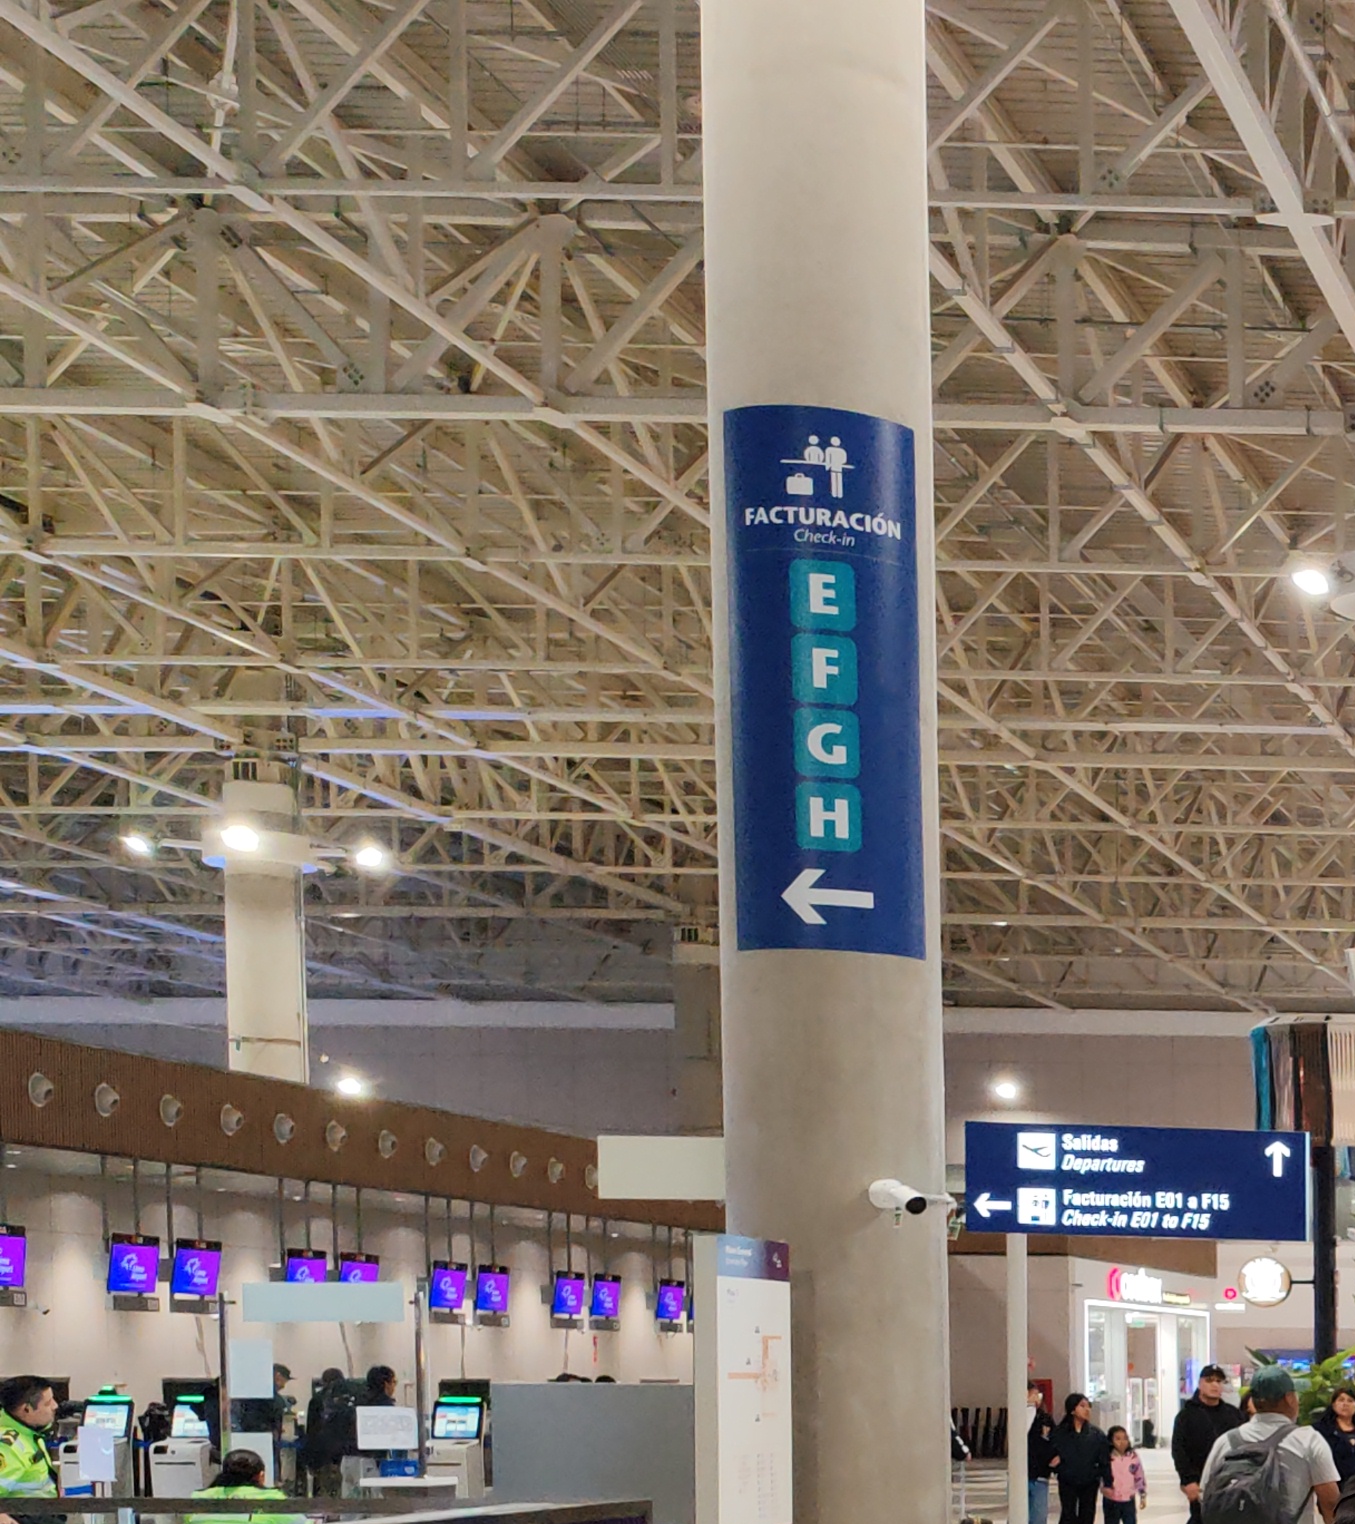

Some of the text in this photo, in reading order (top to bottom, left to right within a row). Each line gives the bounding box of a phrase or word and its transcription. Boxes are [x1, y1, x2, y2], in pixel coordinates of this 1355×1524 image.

[744, 506, 902, 540] FACTURACIÓN
[793, 528, 856, 547] Check-in
[807, 572, 839, 615] E
[811, 648, 840, 689] F
[807, 723, 848, 764] G
[809, 796, 850, 839] H
[1061, 1133, 1119, 1152] Salidas
[1061, 1156, 1146, 1174] Departures
[1061, 1188, 1230, 1211] Facturación E01 a F15
[1061, 1209, 1211, 1230] Check-in E01 to F15
